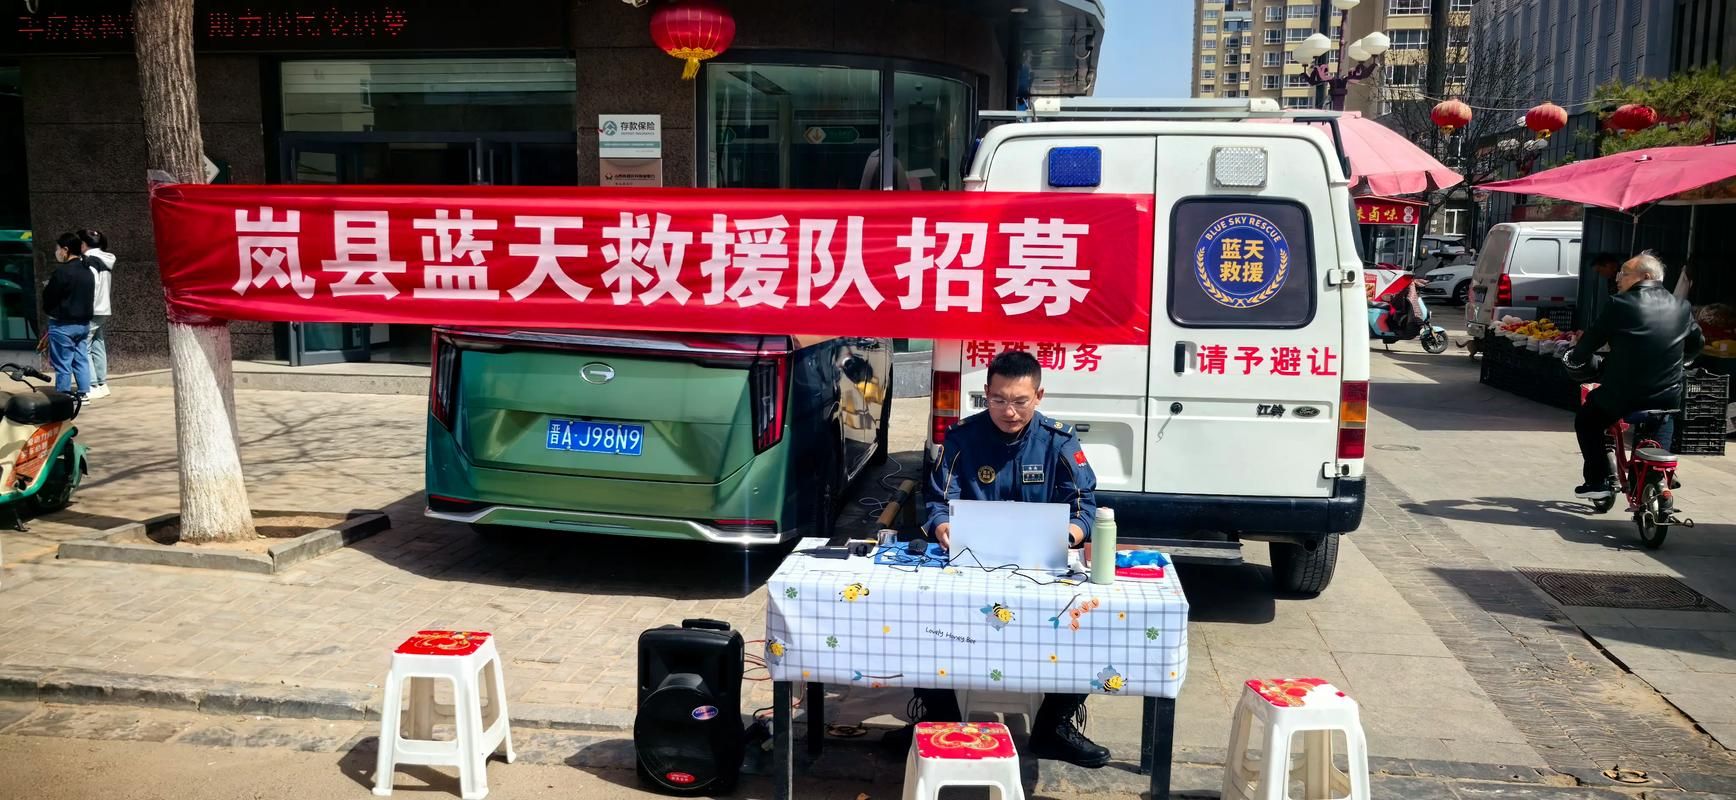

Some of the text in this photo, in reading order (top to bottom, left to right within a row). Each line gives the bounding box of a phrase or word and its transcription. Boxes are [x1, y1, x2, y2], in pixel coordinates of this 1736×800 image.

[620, 121, 655, 131] 存款保险
[1205, 216, 1282, 243] BLUE SKY RESCUE
[1220, 238, 1265, 260] 蓝天
[231, 206, 1091, 317] 岚县蓝天救援队招募
[1219, 261, 1264, 283] 救援
[1197, 344, 1337, 376] 请予避让
[1257, 403, 1286, 418] 江铃
[925, 626, 944, 638] Lovely
[945, 631, 965, 643] Honey
